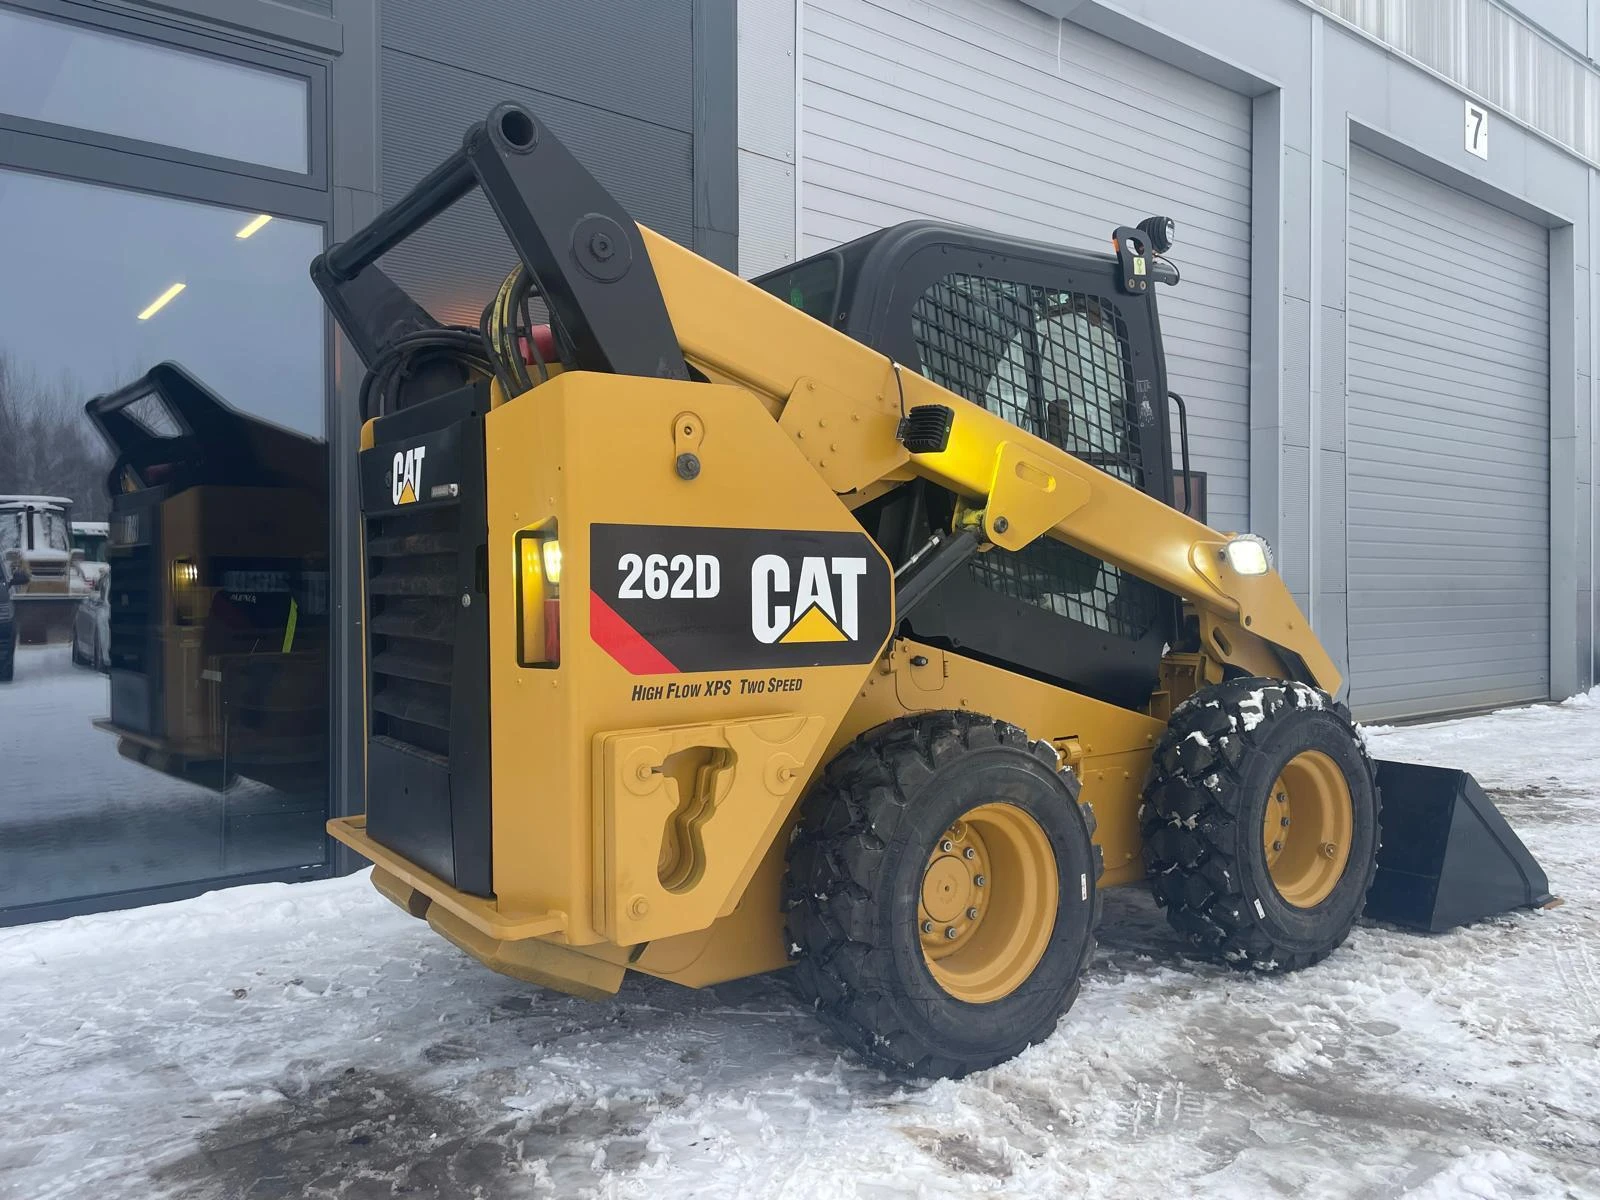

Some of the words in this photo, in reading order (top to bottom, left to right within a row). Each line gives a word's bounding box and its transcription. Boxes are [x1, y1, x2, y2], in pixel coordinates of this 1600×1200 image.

[1471, 108, 1482, 149] 7
[392, 445, 426, 506] CAT
[618, 553, 720, 599] 262D
[751, 554, 867, 644] CAT
[704, 679, 732, 697] XPS
